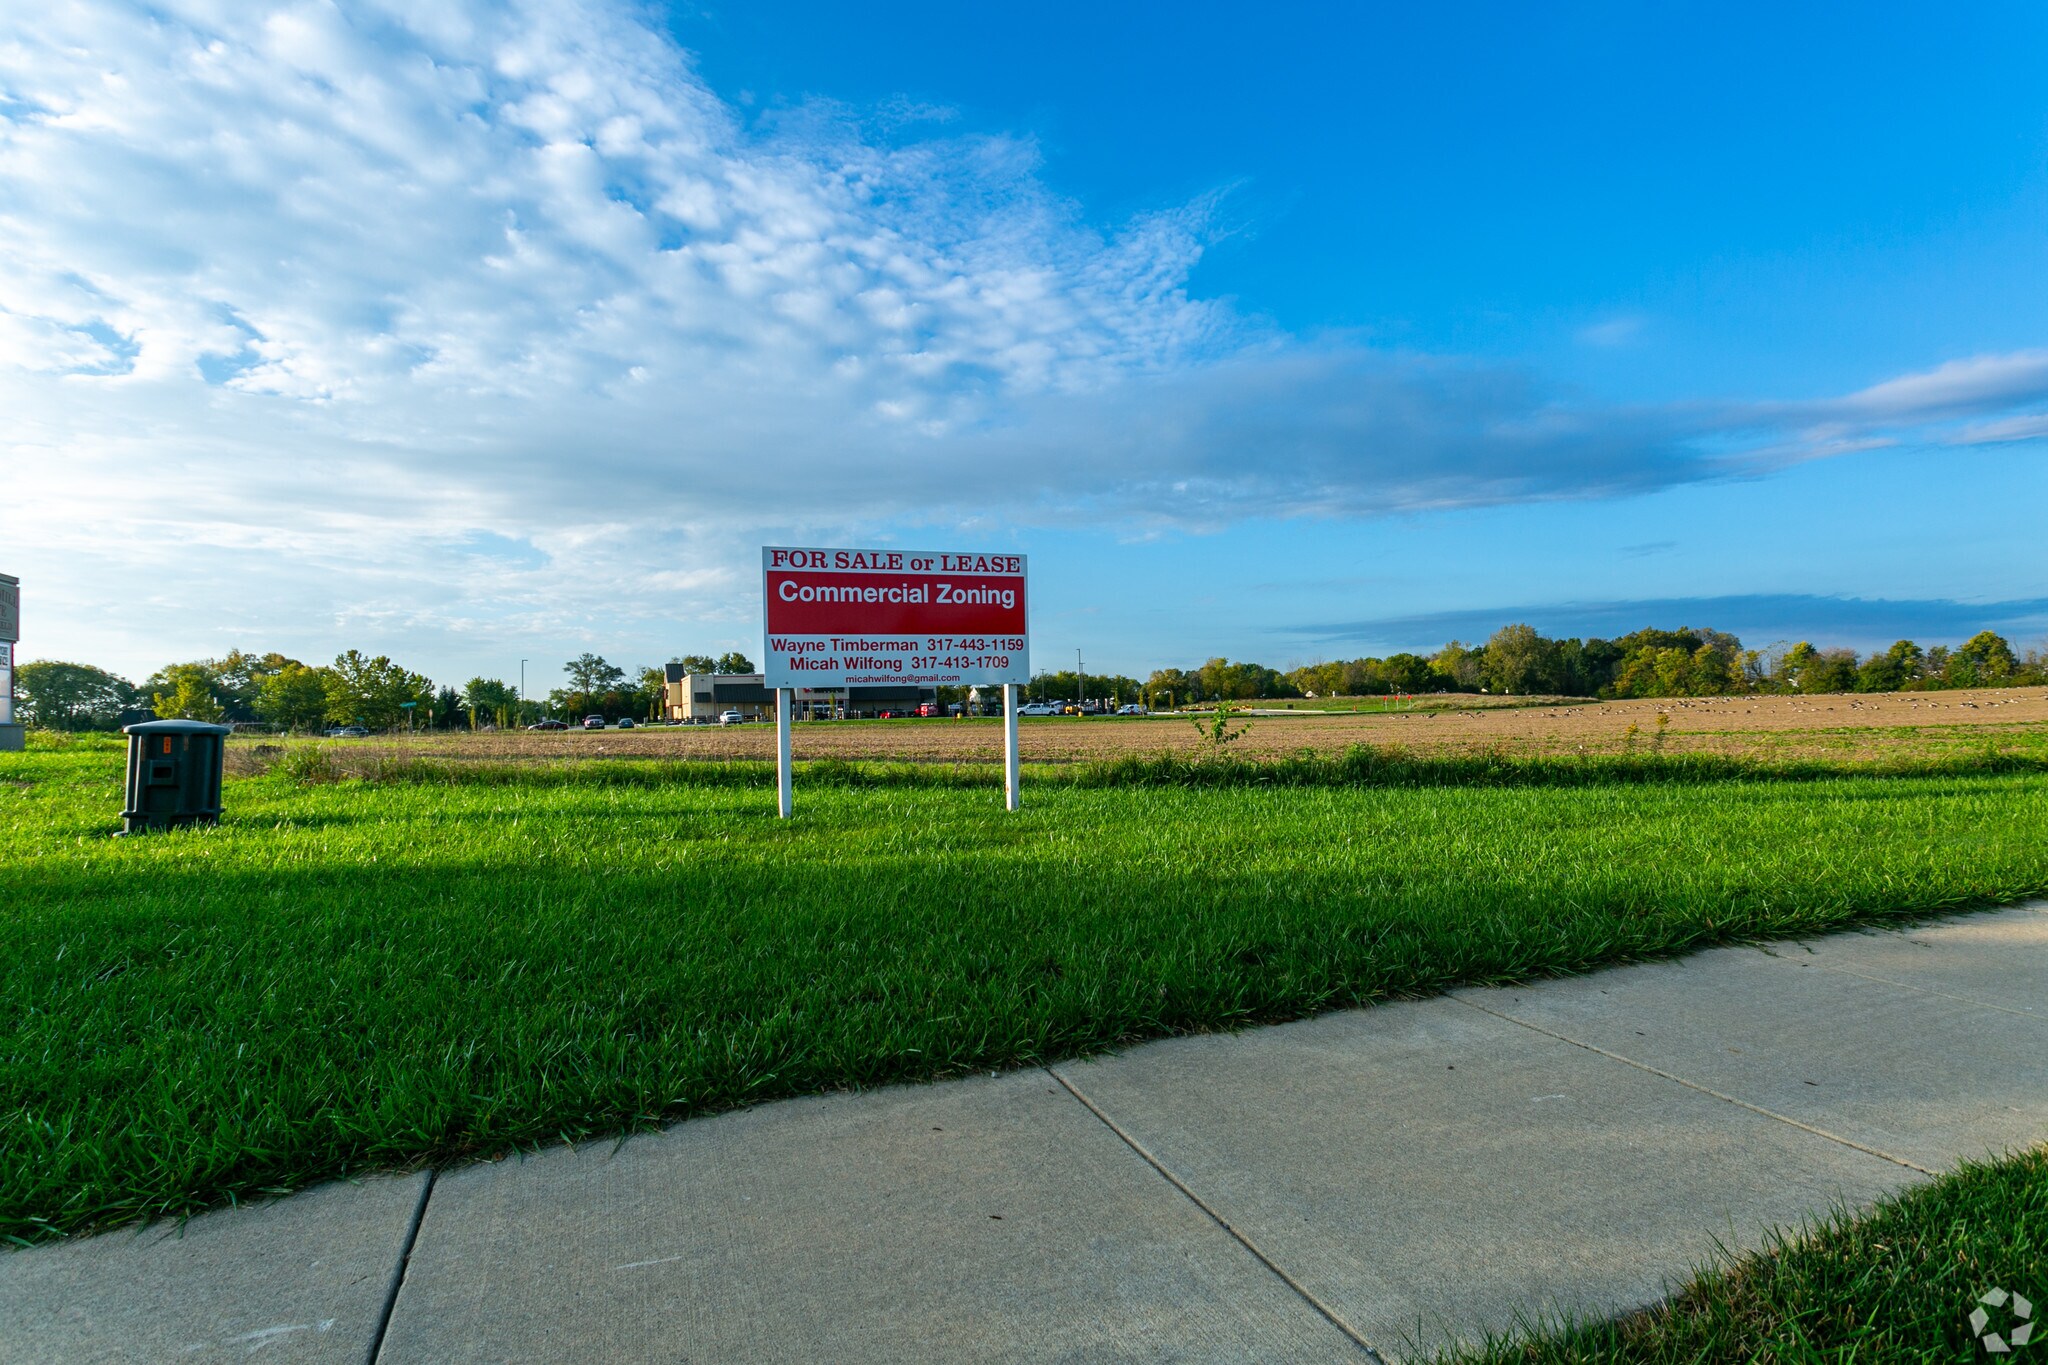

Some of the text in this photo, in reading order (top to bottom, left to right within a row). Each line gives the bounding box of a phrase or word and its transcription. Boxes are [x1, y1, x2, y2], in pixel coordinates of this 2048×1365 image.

[771, 550, 1020, 573] FOR SALE or LEASE
[779, 581, 1015, 609] Commercial Zoning
[771, 638, 1024, 654] Wayne Timberman 317-443-1159
[790, 656, 1009, 672] Micah Wilfong 317-413-1709
[846, 674, 960, 683] micahwilfong@gmail.com
